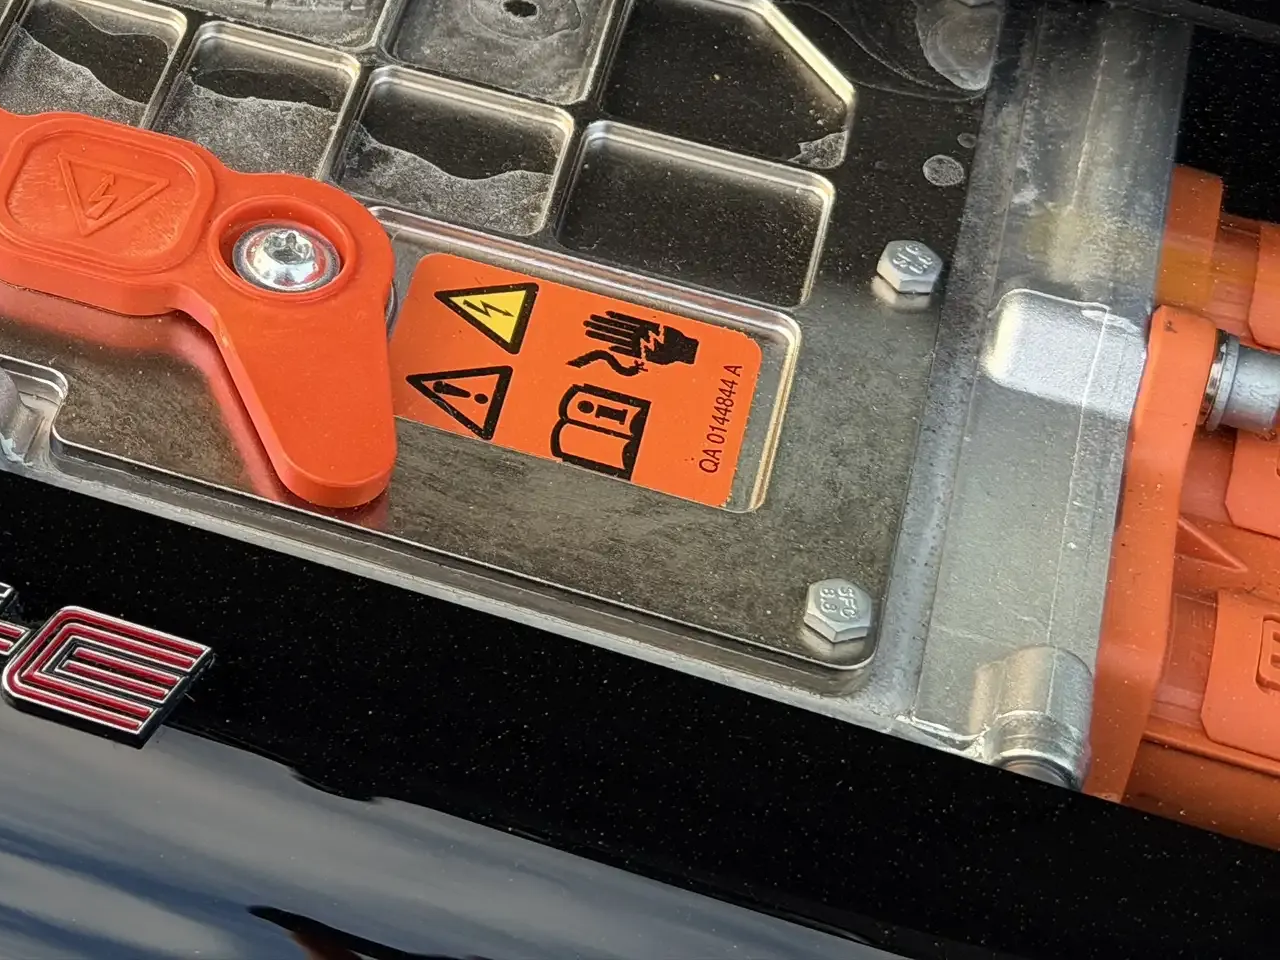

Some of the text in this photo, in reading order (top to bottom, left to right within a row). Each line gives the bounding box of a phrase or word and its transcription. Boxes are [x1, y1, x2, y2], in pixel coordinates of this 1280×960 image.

[698, 365, 743, 473] QA 0144844 A
